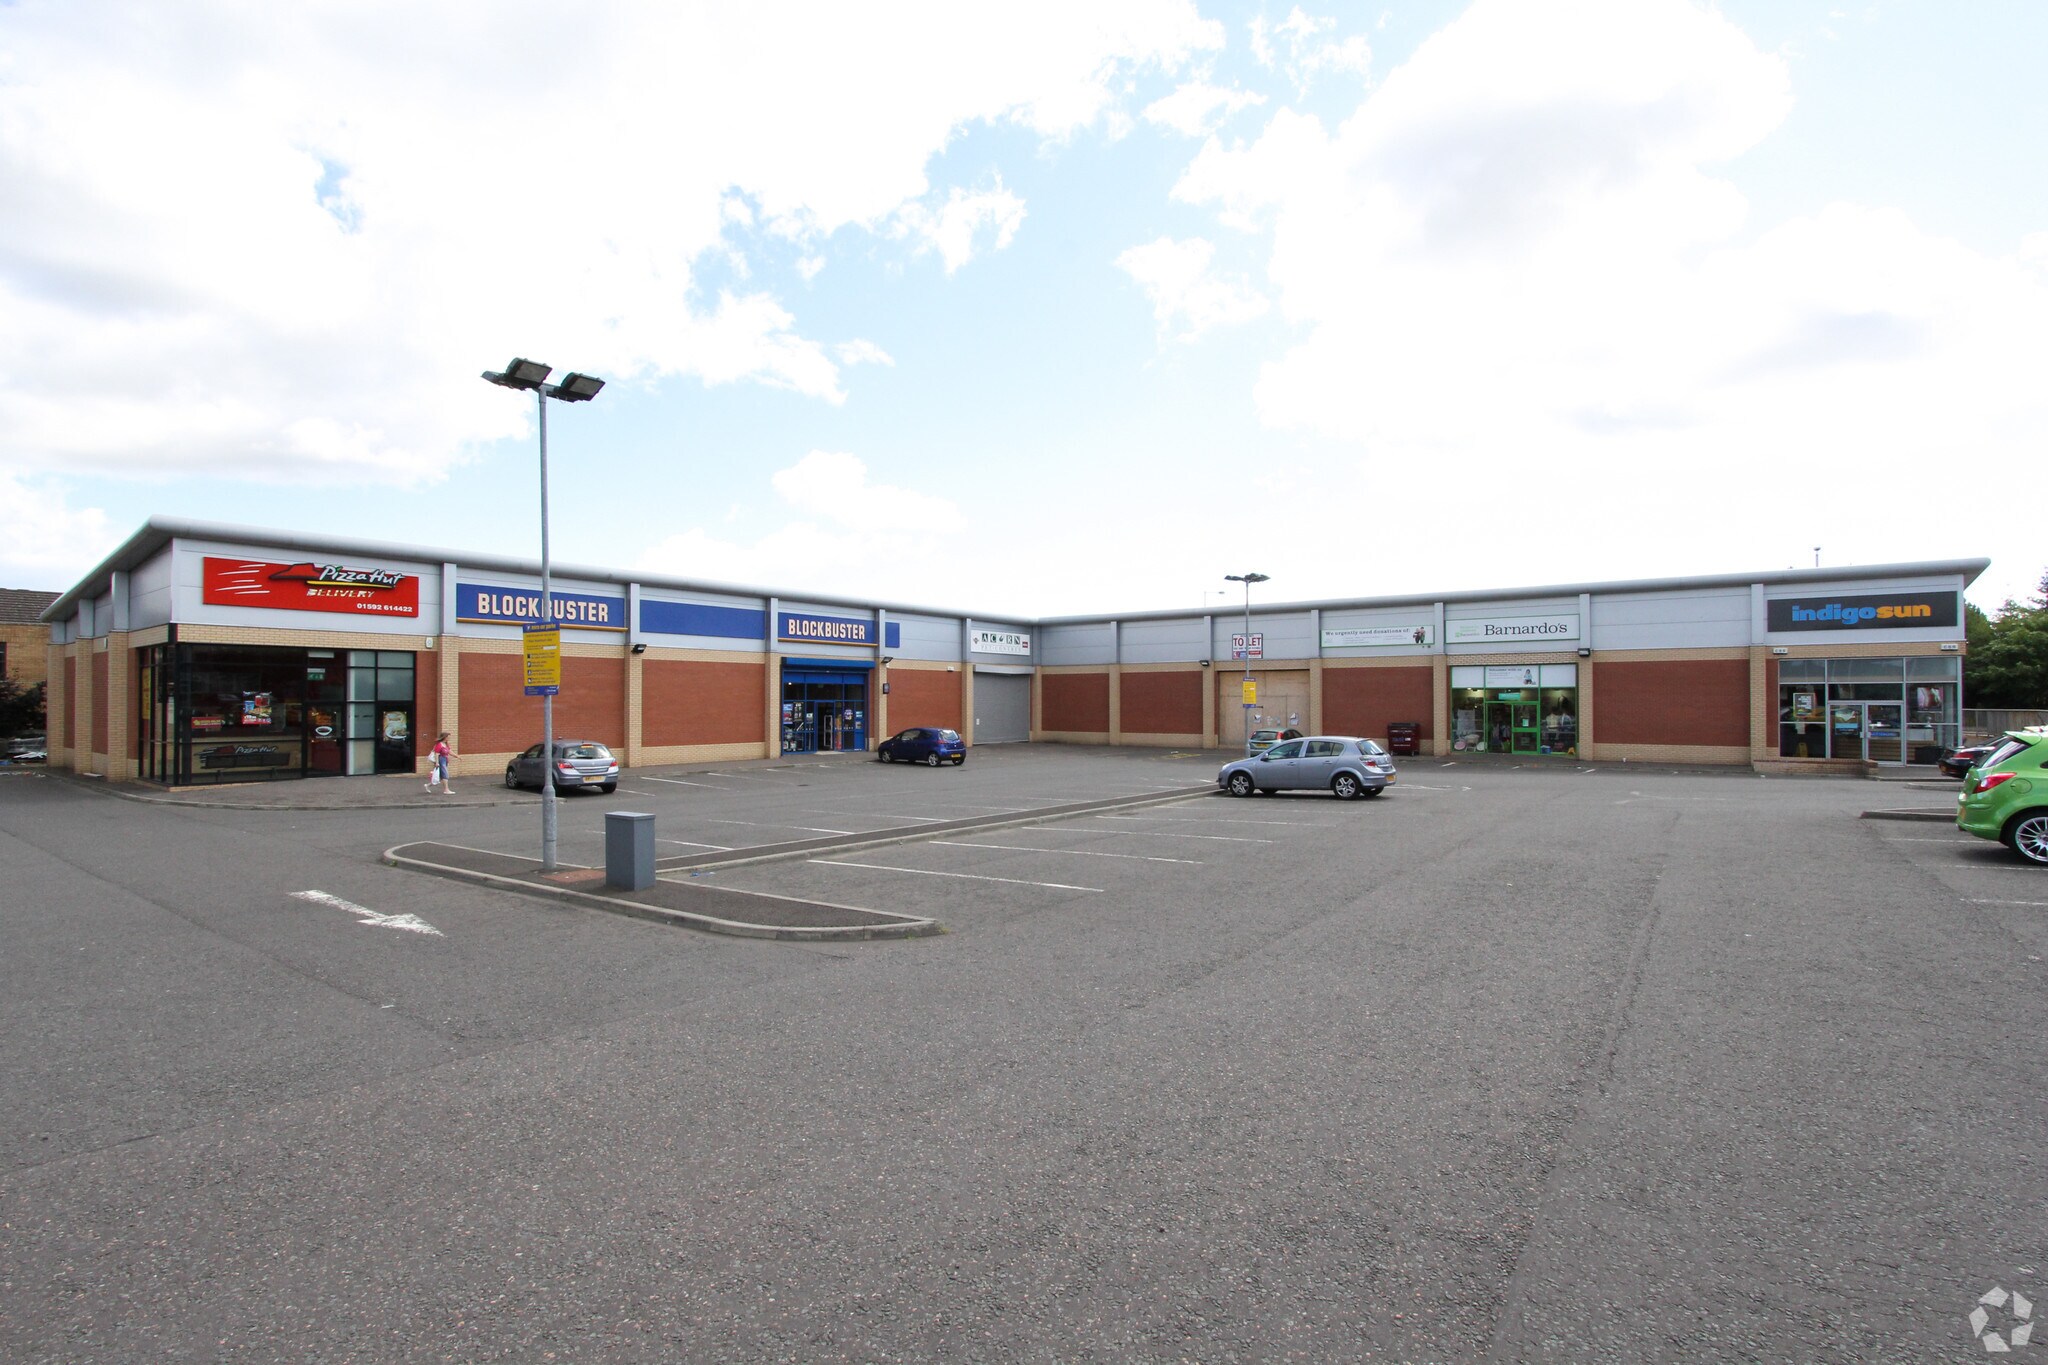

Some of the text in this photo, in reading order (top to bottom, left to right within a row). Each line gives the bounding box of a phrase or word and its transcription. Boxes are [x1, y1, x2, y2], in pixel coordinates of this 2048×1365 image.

[319, 565, 405, 585] Pizza Hut
[306, 588, 376, 598] DELIVERY
[383, 604, 413, 612] 614422
[1791, 603, 1932, 625] indigosun
[788, 618, 865, 640] BLOCKBUSTER
[1484, 622, 1568, 636] Barnardo's
[1233, 637, 1244, 647] TO
